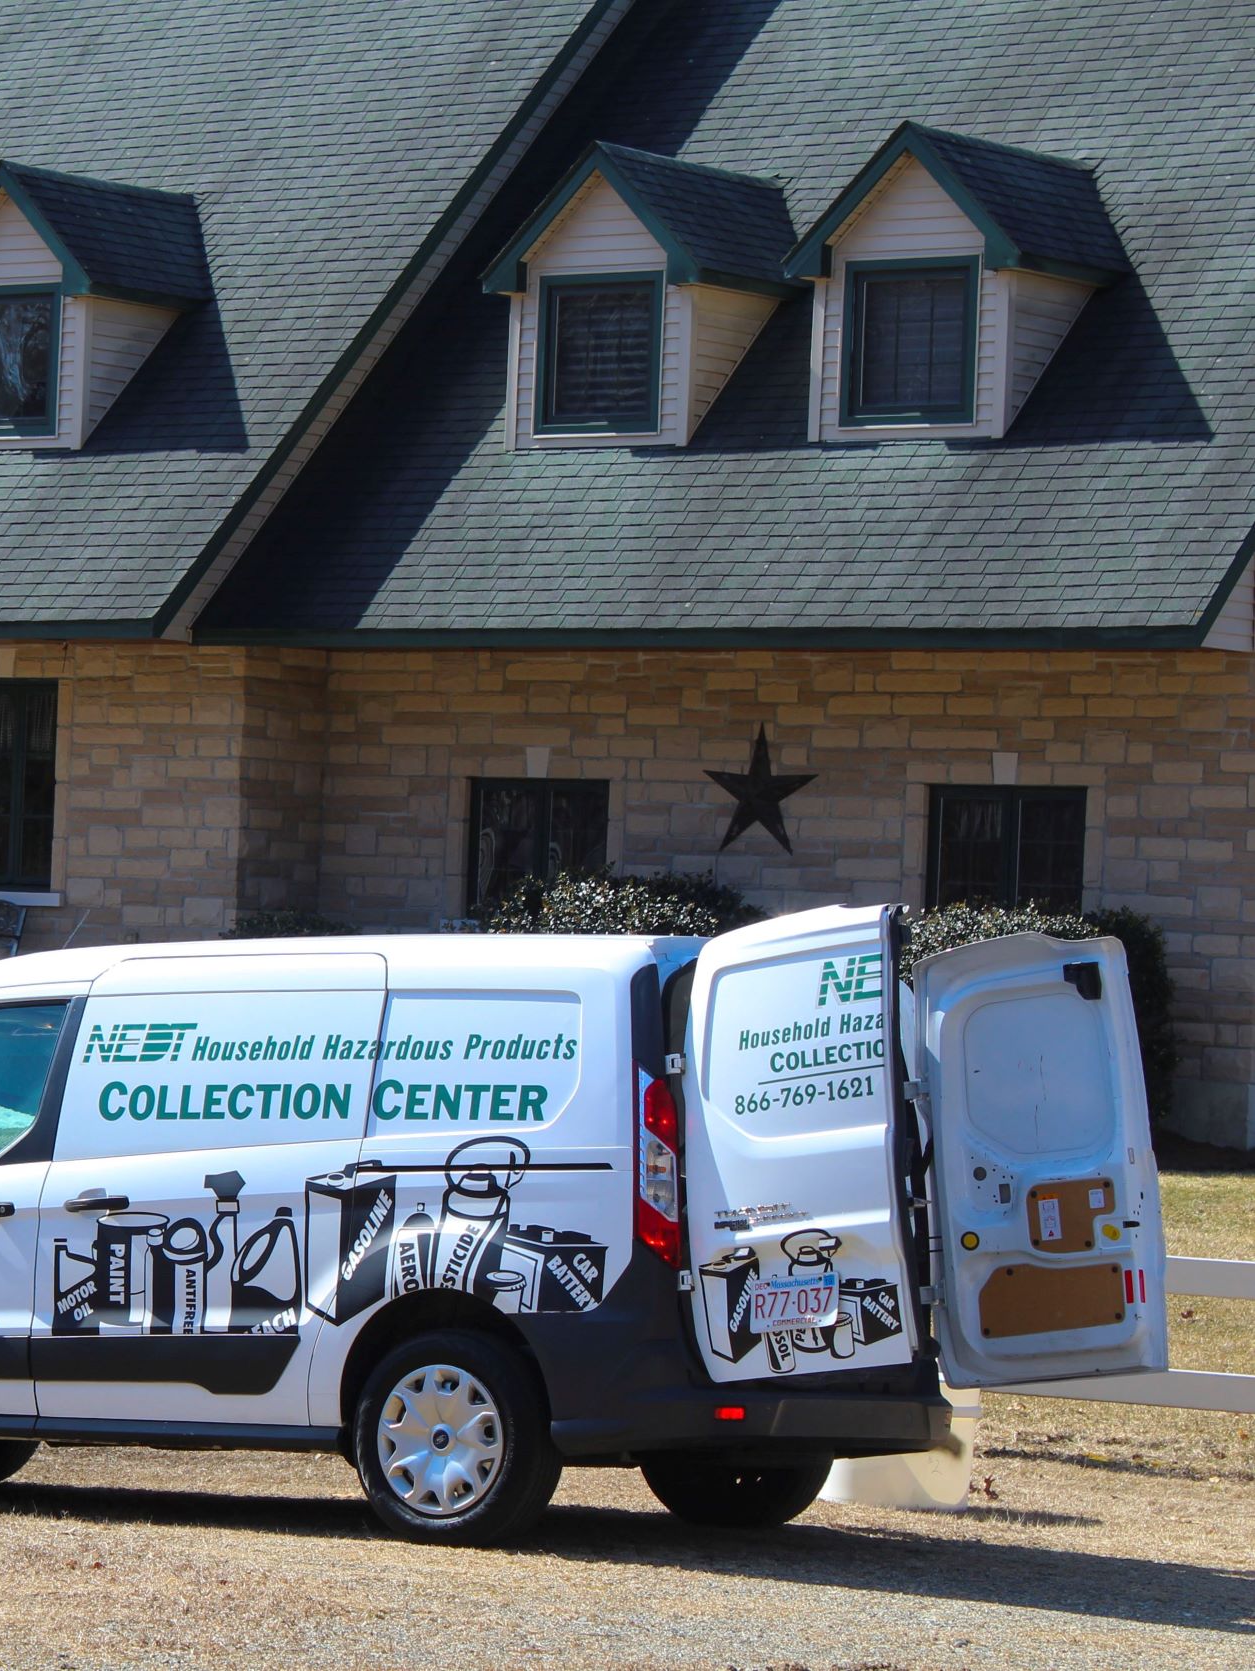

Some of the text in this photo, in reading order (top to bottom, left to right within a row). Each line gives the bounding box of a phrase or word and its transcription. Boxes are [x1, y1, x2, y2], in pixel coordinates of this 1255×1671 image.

[82, 1023, 198, 1063] NEDT
[192, 1033, 578, 1062] Household Hazardous Products
[738, 1016, 831, 1051] Household
[98, 1079, 549, 1122] COLLECTION CENTER
[735, 1075, 874, 1115] 866-769-1621
[341, 1188, 394, 1281] GASOLINE
[109, 1243, 126, 1305] PAINT
[545, 1255, 599, 1312] BATTERY
[572, 1253, 599, 1284] CAR
[57, 1280, 98, 1315] MOTOR
[73, 1301, 94, 1323] OIL
[862, 1295, 901, 1331] BATTERY
[878, 1291, 895, 1311] CAR
[244, 1307, 298, 1335] EACH
[772, 1315, 816, 1327] COMMERCIAL
